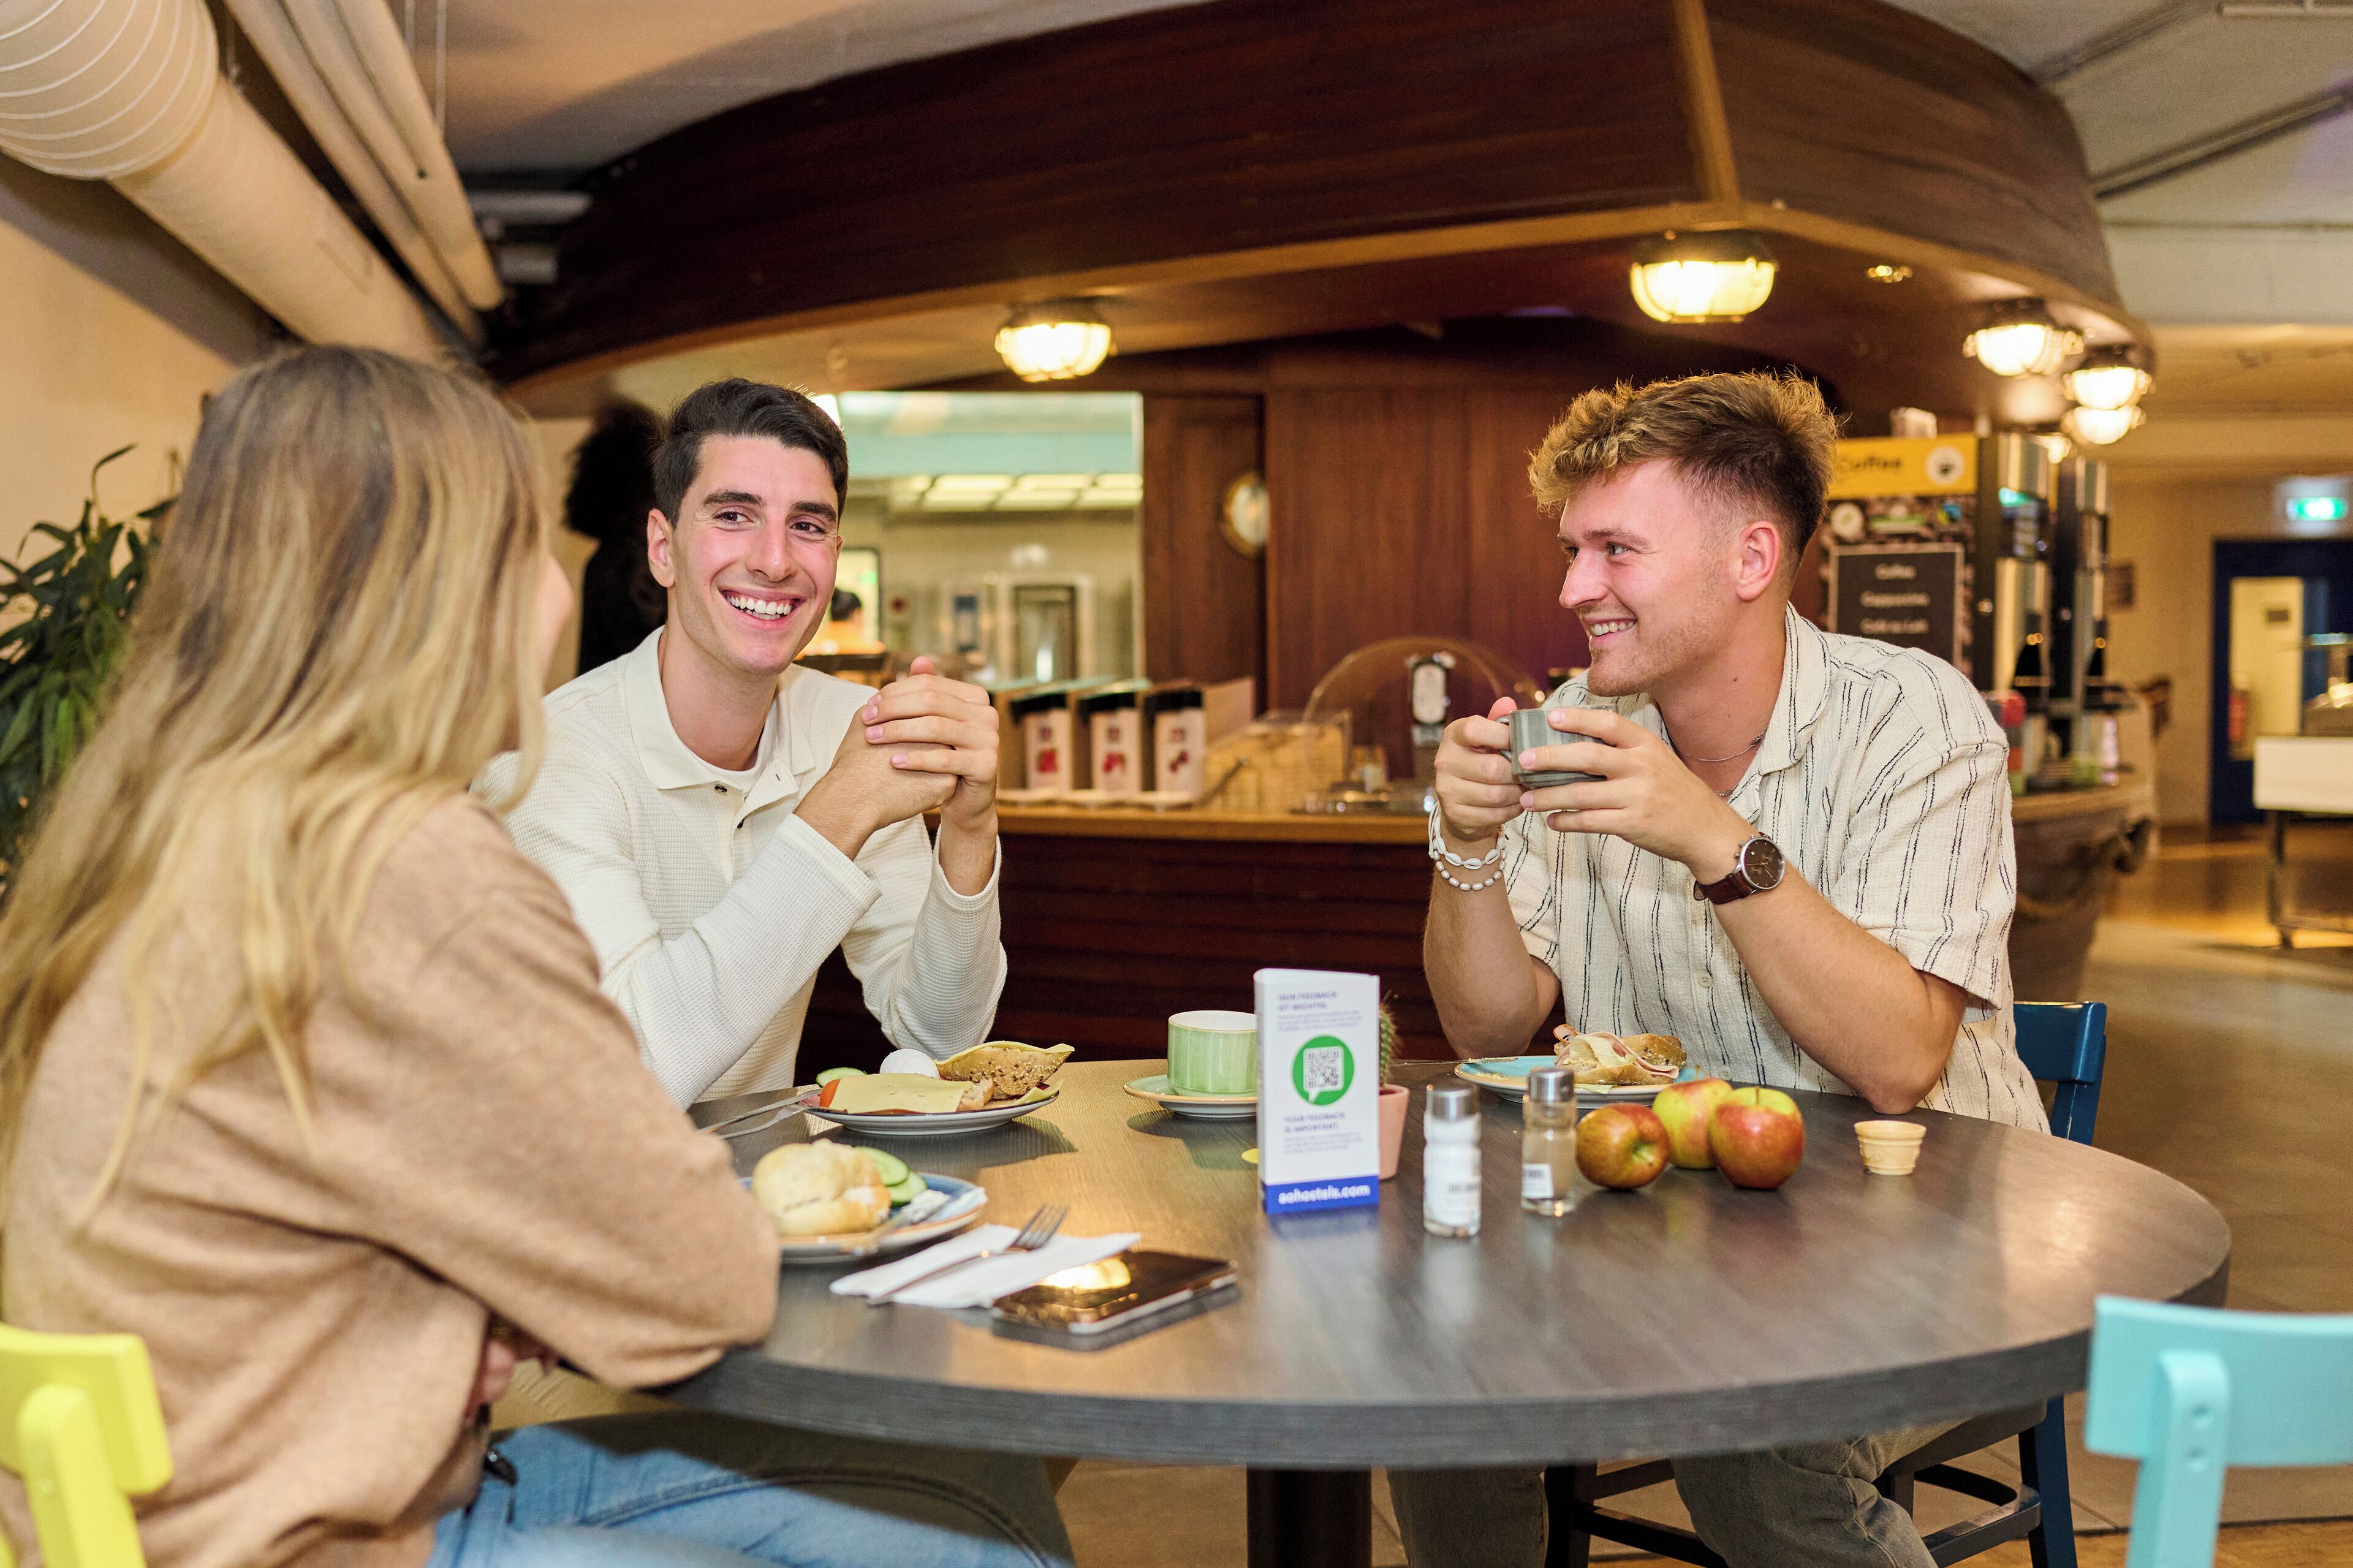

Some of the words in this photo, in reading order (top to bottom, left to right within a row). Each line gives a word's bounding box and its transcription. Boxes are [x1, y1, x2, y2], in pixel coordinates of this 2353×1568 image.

[1297, 991, 1337, 999] FEEDBACK
[1306, 1112, 1345, 1121] FEEDBACK
[1278, 1184, 1371, 1205] aohostels.com
